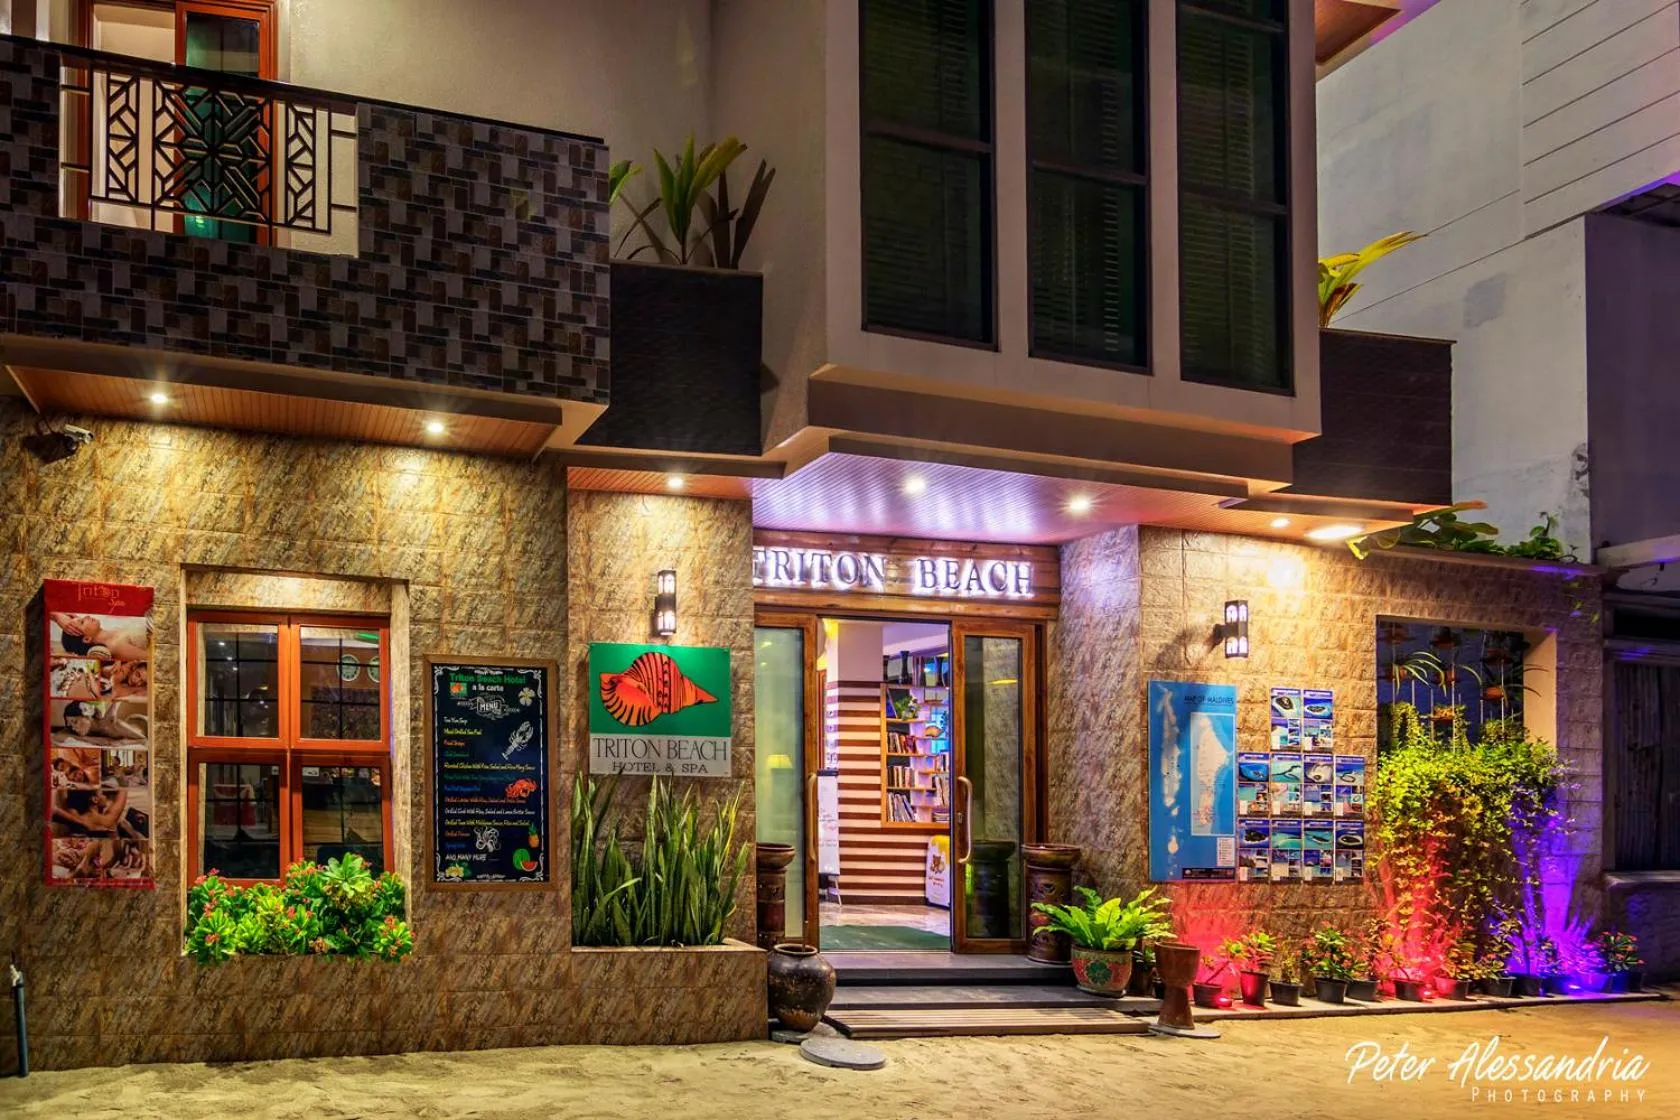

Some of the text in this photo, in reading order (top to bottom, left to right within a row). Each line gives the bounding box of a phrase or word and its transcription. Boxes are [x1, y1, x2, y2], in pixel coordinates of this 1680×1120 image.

[752, 549, 1033, 594] TRITON BEACH
[504, 675, 526, 684] Hotel
[480, 701, 499, 711] MENU
[592, 737, 727, 761] TRITON BEACH
[612, 761, 709, 774] HOTEL & SPA
